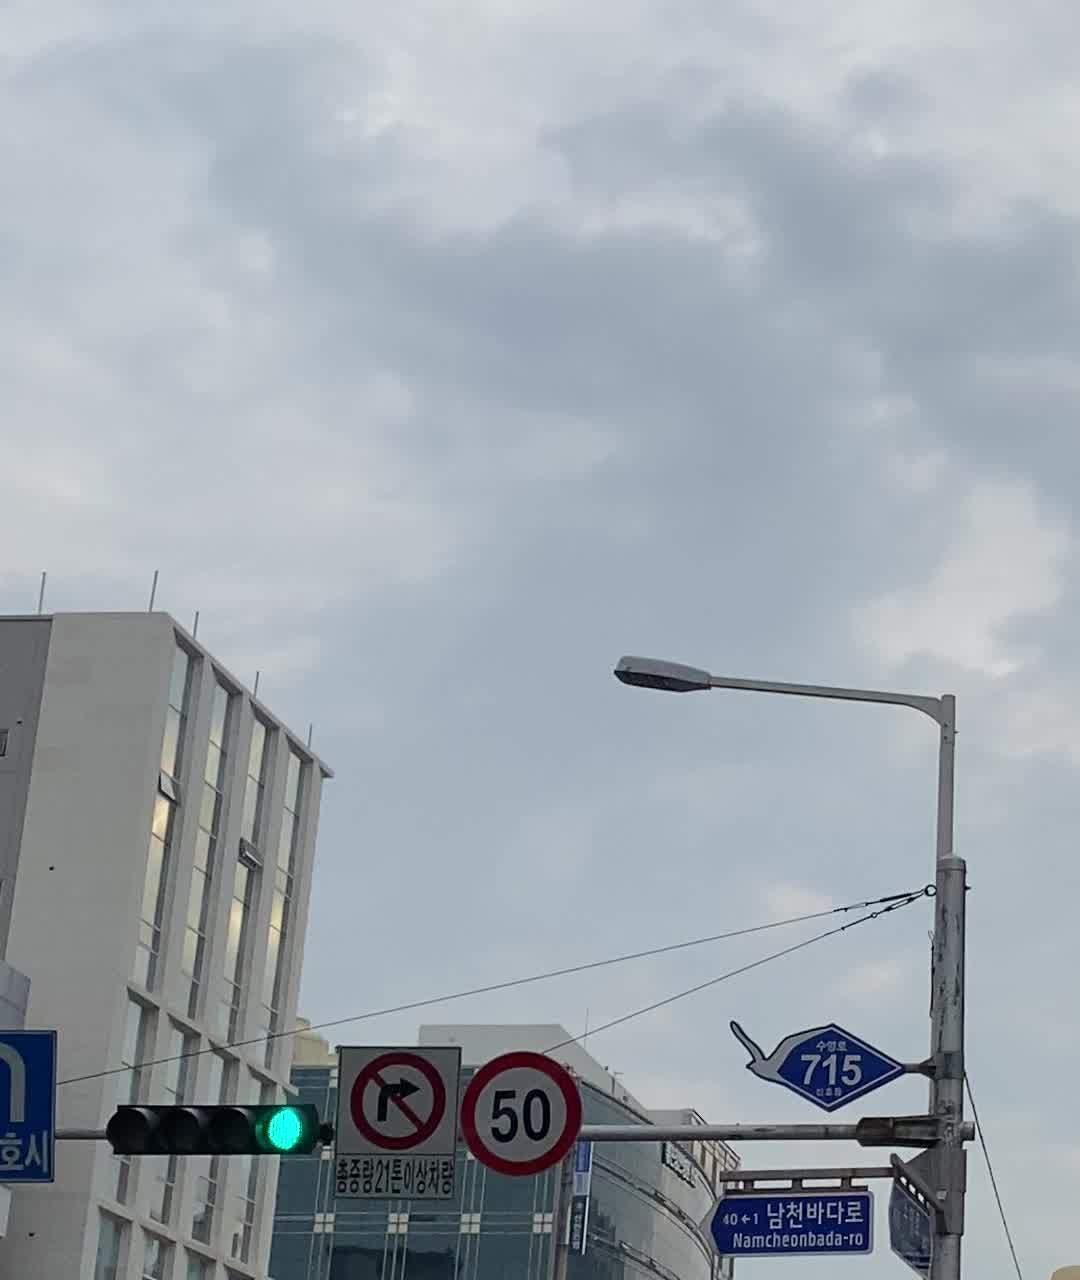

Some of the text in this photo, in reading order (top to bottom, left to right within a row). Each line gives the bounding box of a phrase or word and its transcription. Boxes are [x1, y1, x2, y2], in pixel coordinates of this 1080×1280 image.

[815, 1040, 847, 1052] 수영로
[801, 1054, 861, 1086] 715
[491, 1088, 550, 1142] 50
[767, 1201, 864, 1229] 남천바다로
[733, 1231, 863, 1248] Namcheonbada-ro
